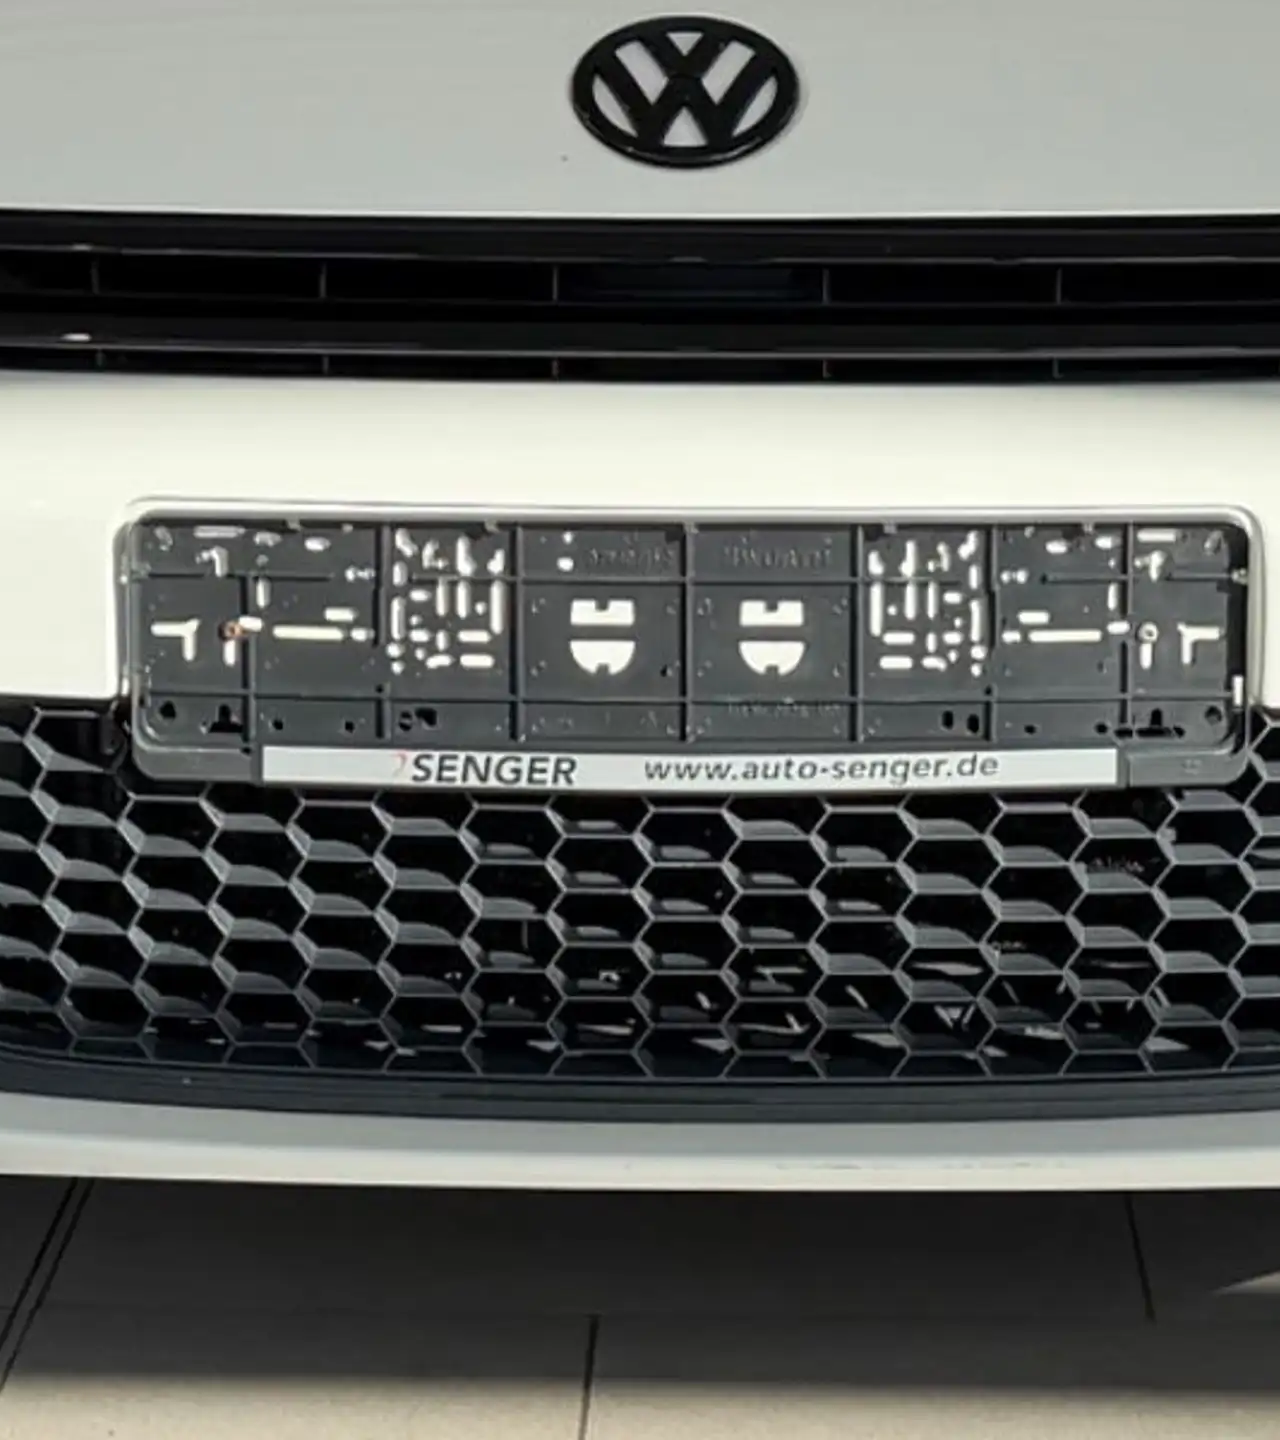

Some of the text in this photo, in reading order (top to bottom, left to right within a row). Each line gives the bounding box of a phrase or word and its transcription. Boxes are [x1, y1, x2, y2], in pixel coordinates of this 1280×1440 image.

[580, 21, 790, 162] VW
[411, 753, 1000, 787] SENGER www.auto-senger.de
